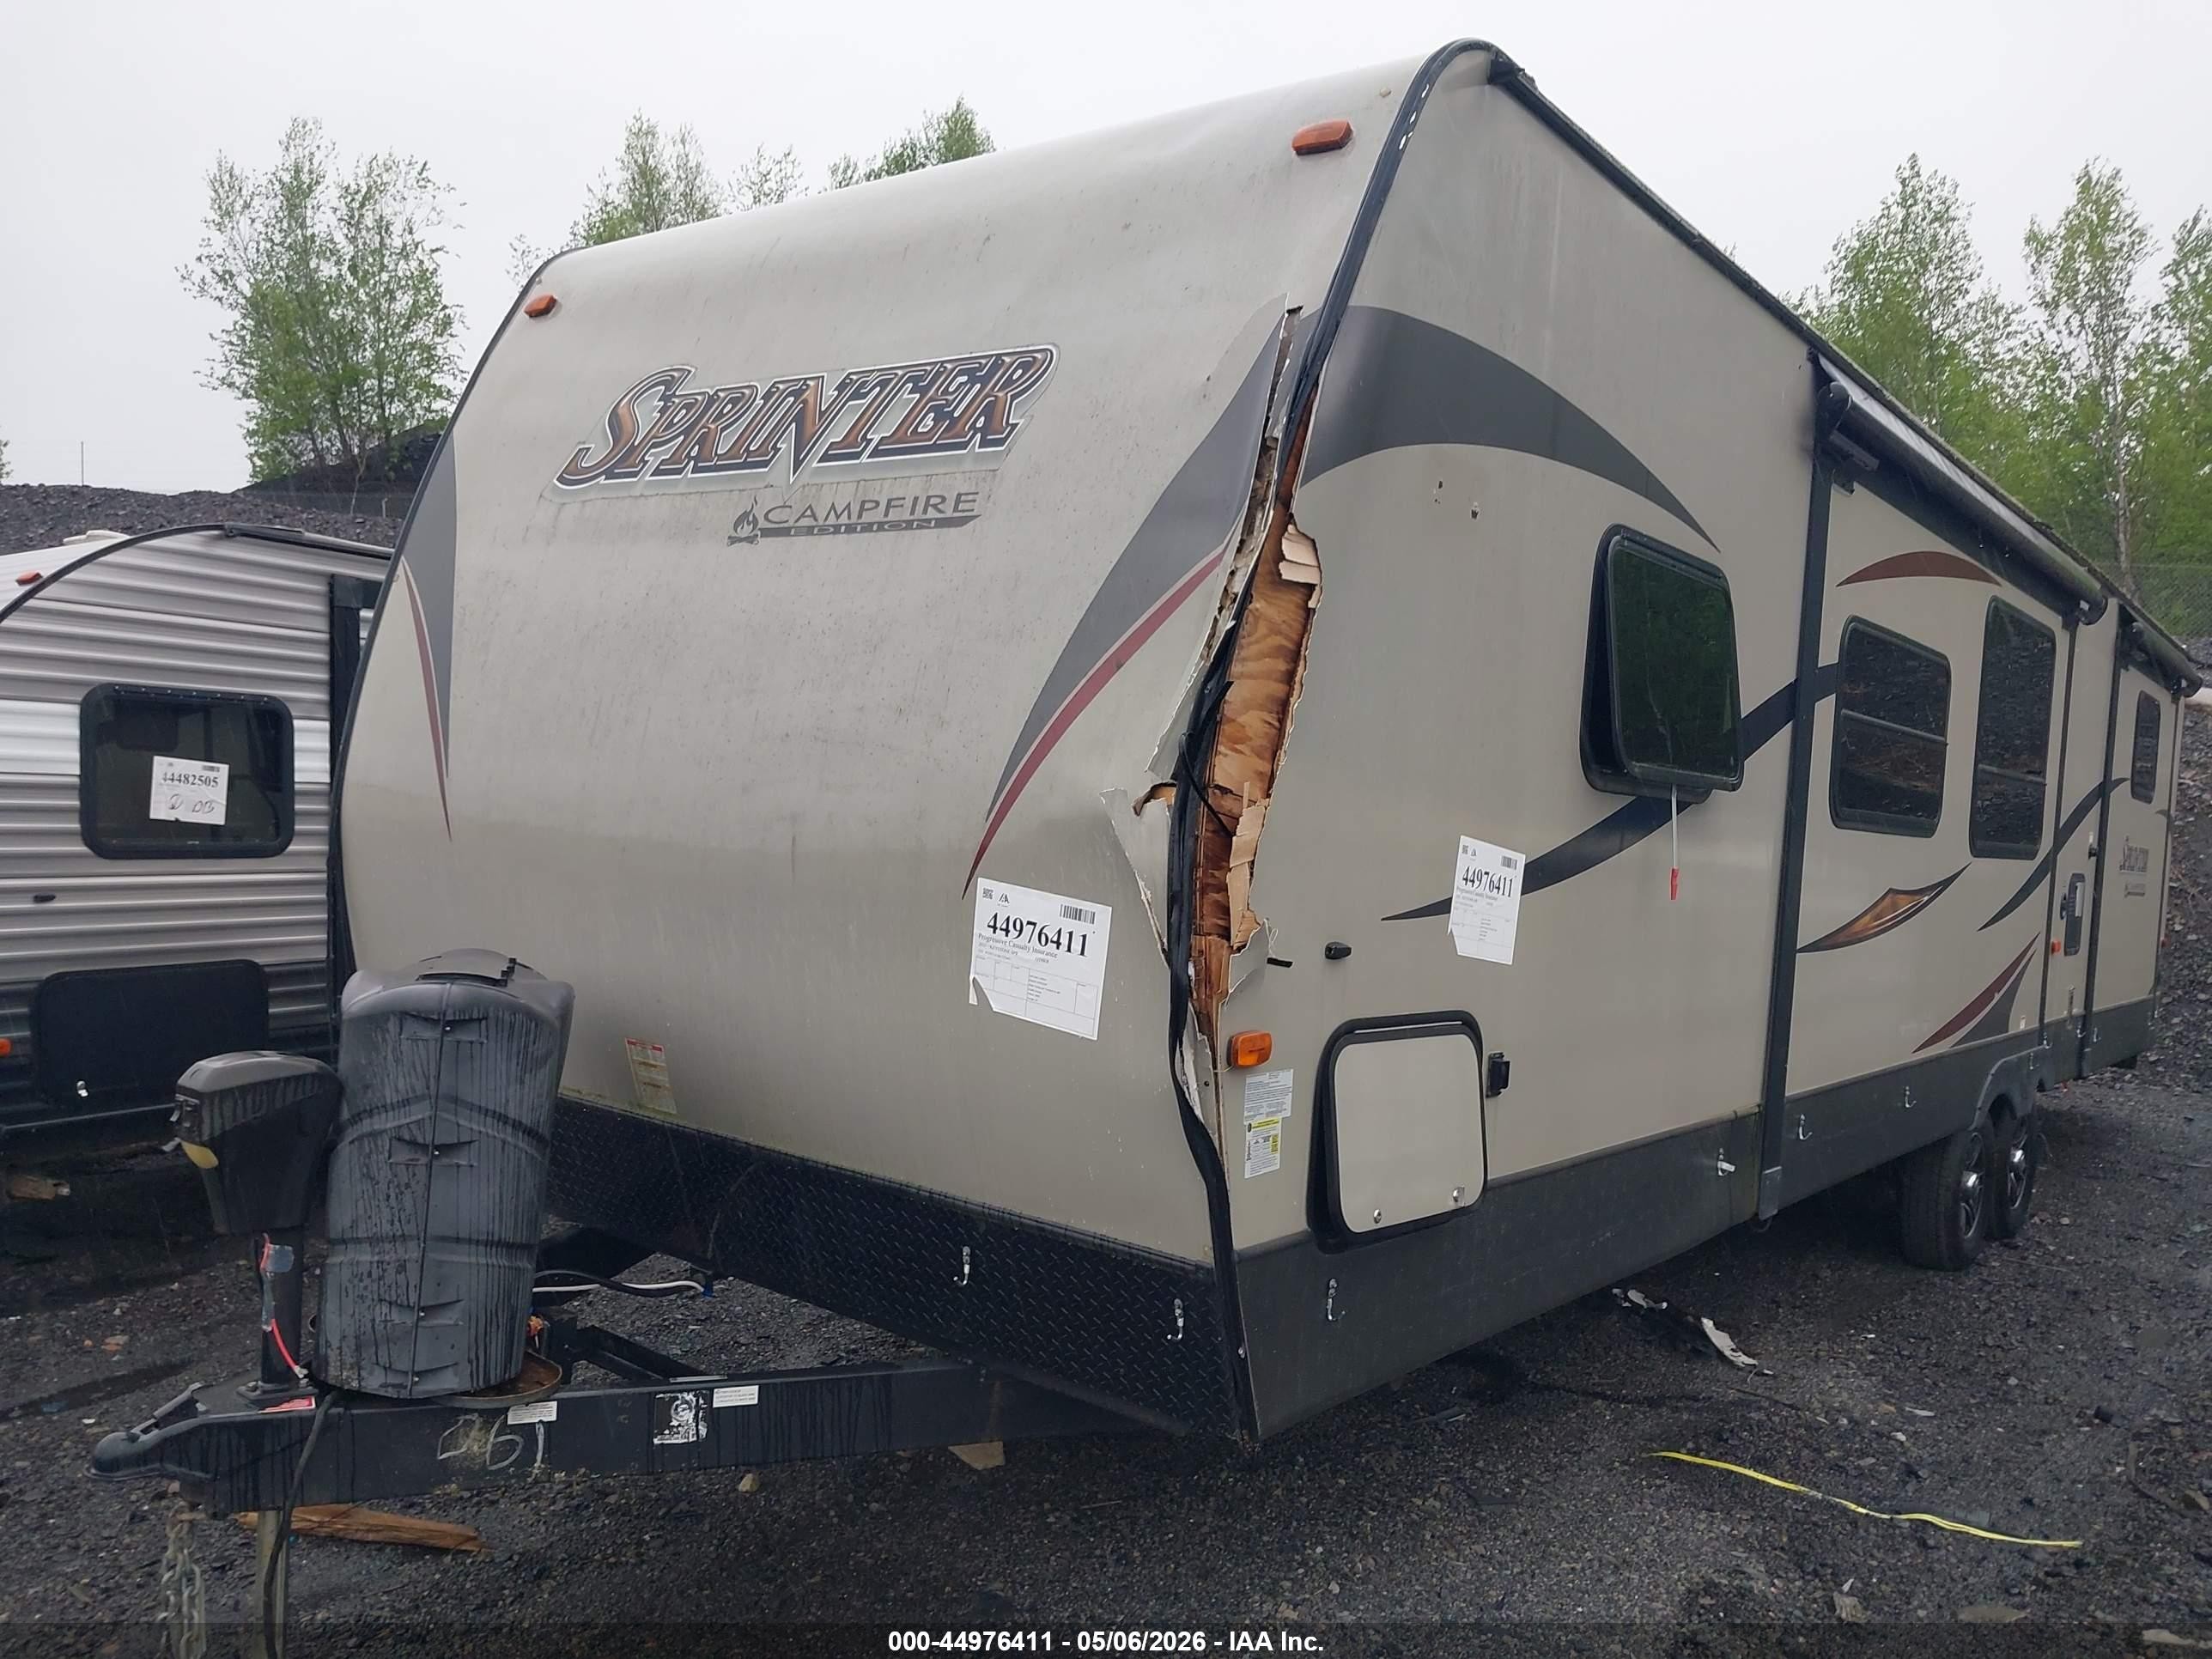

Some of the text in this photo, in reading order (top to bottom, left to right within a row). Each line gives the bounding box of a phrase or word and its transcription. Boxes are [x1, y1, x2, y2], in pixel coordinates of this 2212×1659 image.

[554, 343, 1060, 488] SPRINTER
[763, 490, 981, 526] CAMPFIRE
[789, 519, 937, 536] EDITION
[1462, 865, 1513, 898] 44976411
[987, 911, 1089, 958] 44976411
